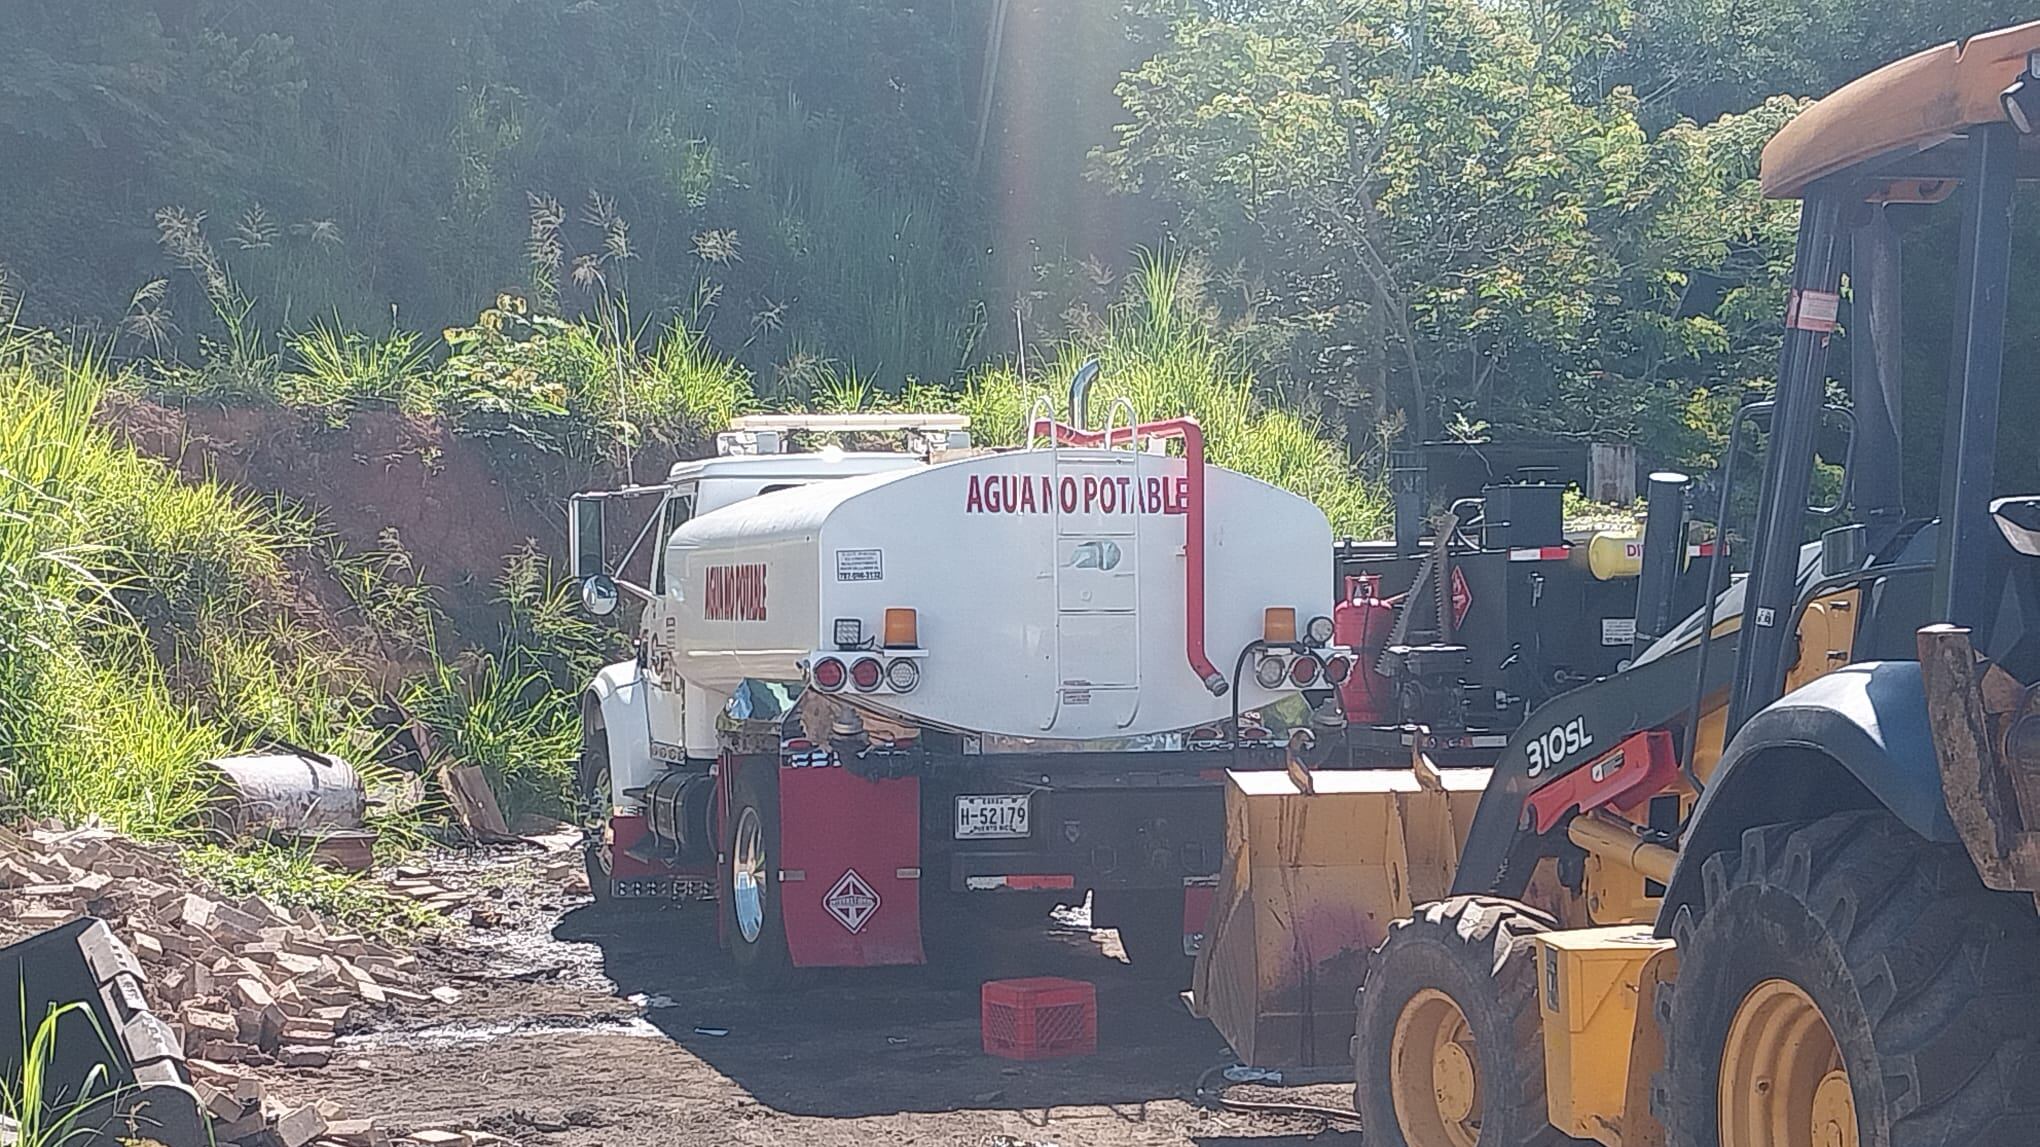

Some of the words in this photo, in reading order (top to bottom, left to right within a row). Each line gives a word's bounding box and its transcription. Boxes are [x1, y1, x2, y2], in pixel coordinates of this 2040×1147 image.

[966, 475, 1037, 514] AGUA
[1042, 475, 1078, 514] NO
[1083, 475, 1188, 515] POTABLE
[1526, 716, 1593, 778] 310SL
[960, 806, 1026, 826] H-52179
